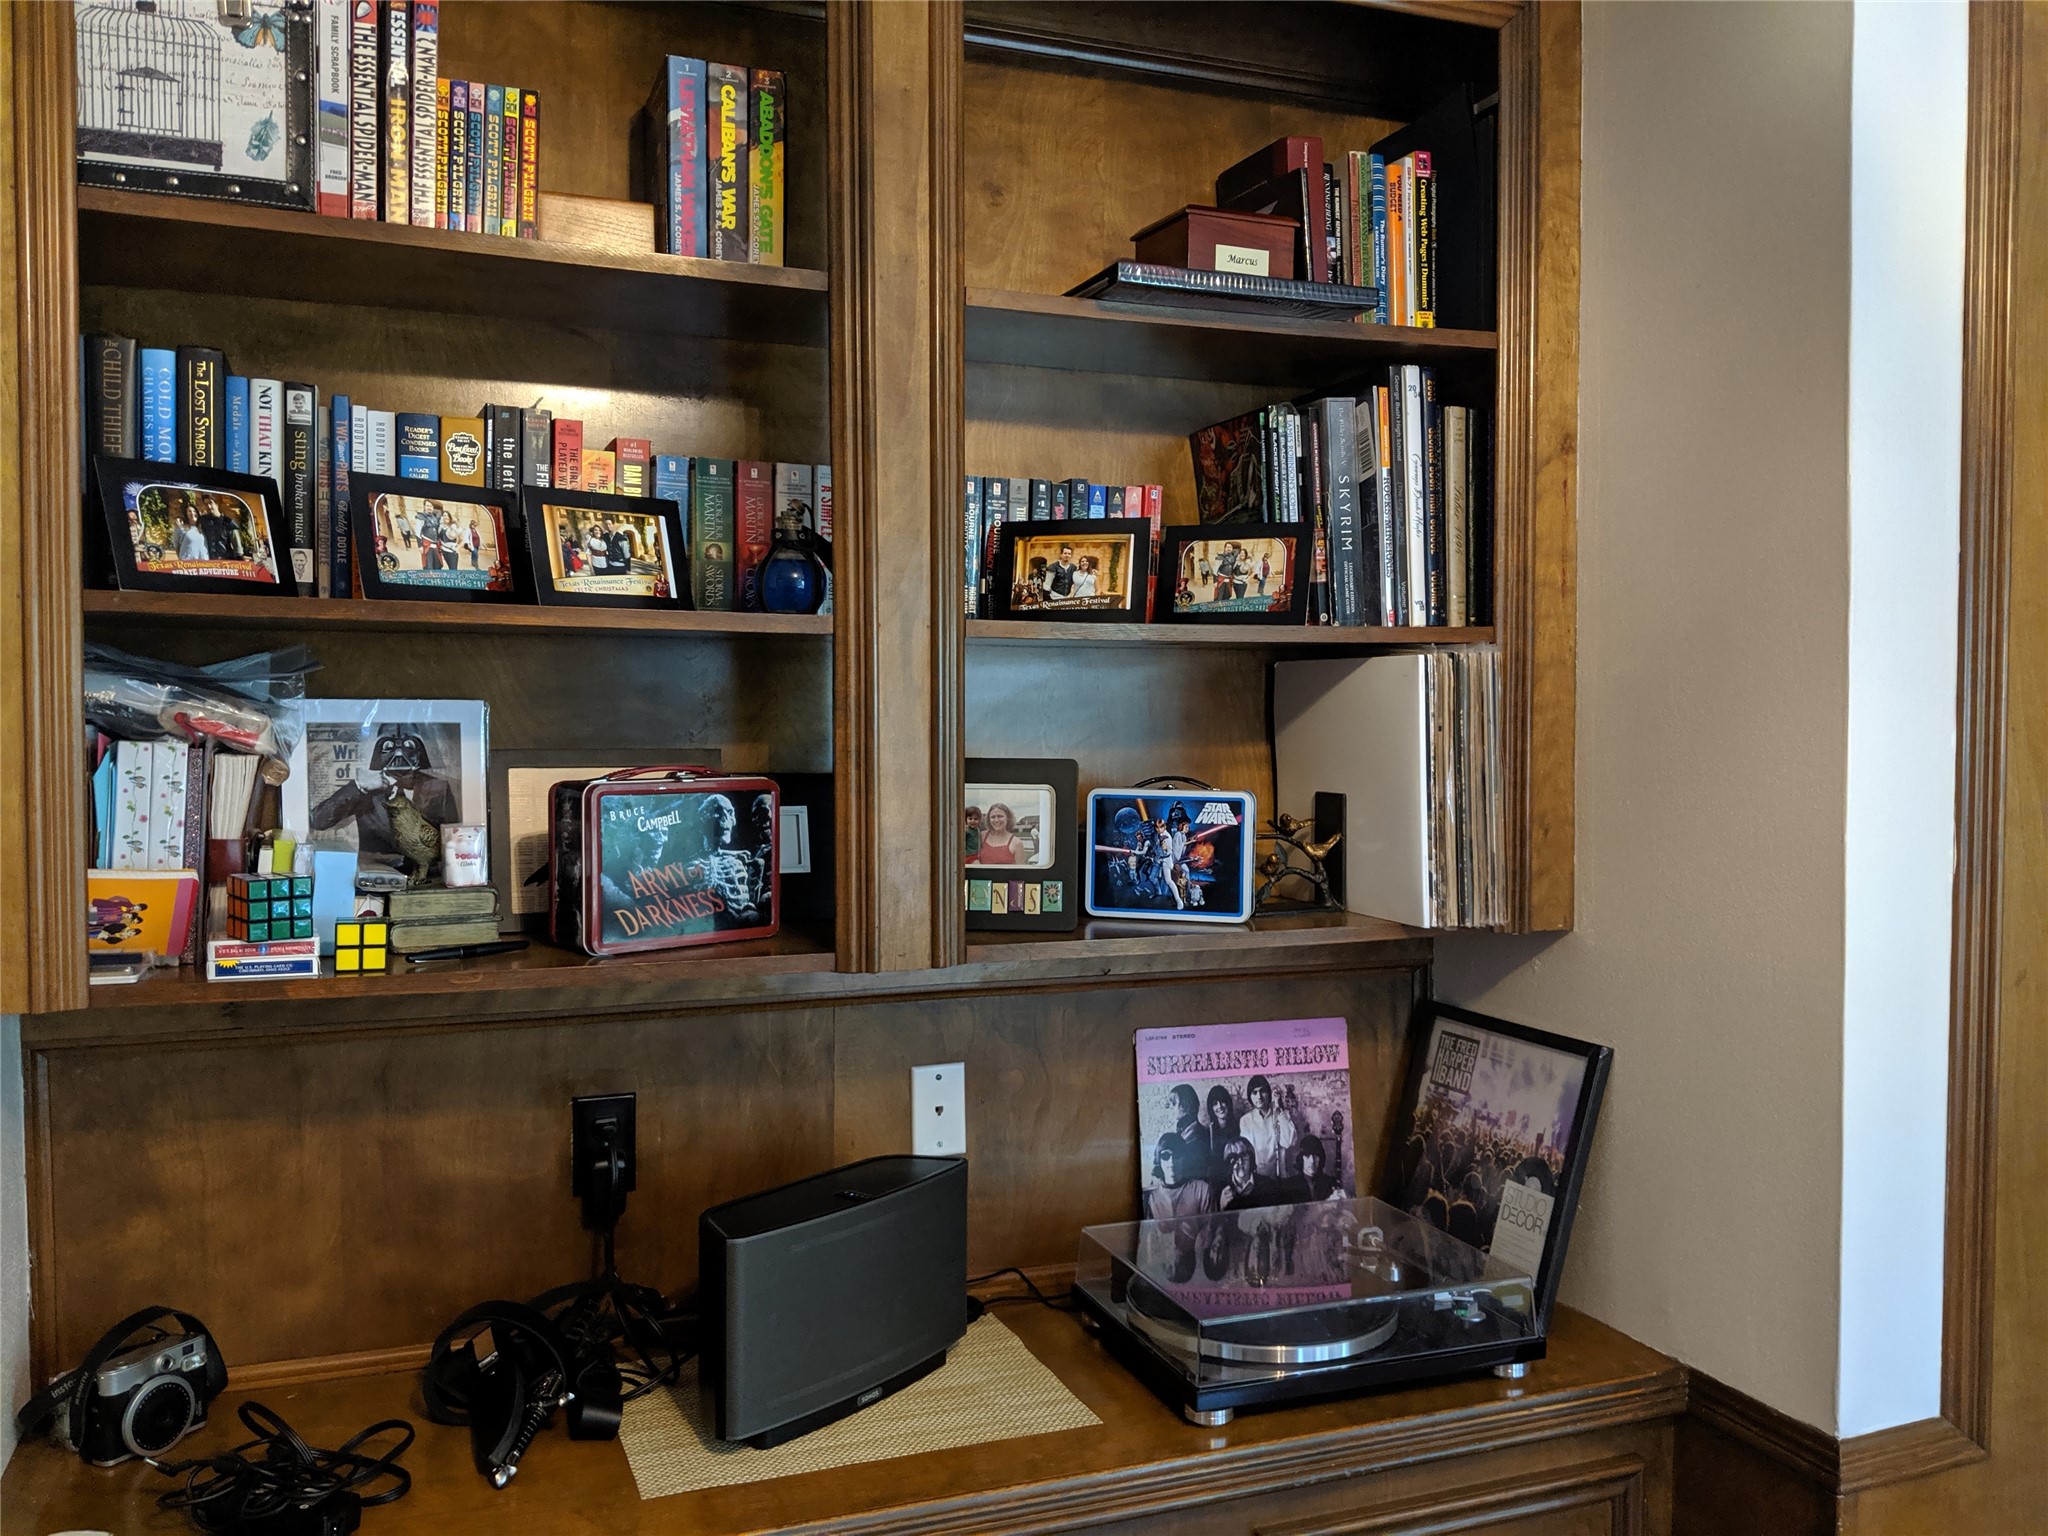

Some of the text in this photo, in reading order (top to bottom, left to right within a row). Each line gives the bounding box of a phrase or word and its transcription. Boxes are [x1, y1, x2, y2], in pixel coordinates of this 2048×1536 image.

[330, 15, 340, 94] FAMILY SCRAPBOOK
[354, 26, 376, 201] THE ESSENTIAL SPIDER-MAN
[388, 10, 406, 222] ESSENTIAL IRON MAN
[413, 47, 436, 206] THE ESSENTIAL SPIDER-MAN
[679, 77, 696, 188] LEVIATHAN
[721, 84, 736, 182] CALIBAN'S
[758, 91, 774, 200] ABADDON'S
[437, 110, 448, 212] SCOTT PILGRIM
[452, 111, 464, 214] SCOTT PILGRIM
[469, 113, 481, 215] SCOTT PILGRIM
[487, 114, 499, 216] SCOTT PILGRIM
[504, 117, 516, 219] SCOTT PILGRIM
[522, 120, 536, 222] SCOTT PILGRIM
[722, 188, 736, 230] WAR
[1419, 179, 1428, 216] Creating
[760, 204, 774, 255] GATE
[752, 236, 760, 264] COREY
[1226, 254, 1258, 267] Marcus
[1420, 236, 1428, 262] Pages
[1421, 268, 1429, 308] Dummies
[196, 361, 206, 378] The
[102, 348, 122, 454] CHILD THIEF
[144, 366, 154, 430] CHARLES
[158, 368, 171, 420] COLD
[1394, 375, 1402, 401] George
[232, 396, 242, 430] Medals
[258, 385, 272, 448] NOT THAT
[1394, 420, 1402, 434] High
[354, 416, 364, 446] RODDY
[376, 422, 386, 448] RODDY
[400, 438, 438, 448] CONDENSED
[404, 426, 434, 434] READER'S
[452, 454, 474, 465] Books
[502, 438, 516, 459] the
[558, 442, 568, 474] PLAYED
[320, 460, 330, 488] PINTS
[336, 461, 349, 492] PINTS
[536, 463, 549, 472] THE
[569, 448, 579, 487] THE GIRL
[598, 475, 608, 490] THE
[624, 464, 642, 484] DAN
[1288, 450, 1296, 490] ROBINSON'S
[291, 430, 312, 543] sting broken music
[704, 492, 715, 540] MARTIN
[714, 494, 723, 524] GEORGE
[746, 496, 756, 543] MARTIN
[756, 497, 764, 528] GEORGE
[1016, 506, 1026, 521] THE
[1338, 475, 1353, 551] SKYRIM
[320, 504, 330, 566] RODDY DOYLE
[336, 500, 348, 564] Roddy DOYLE
[993, 513, 1002, 554] BOURNE
[1383, 477, 1394, 578] ROCKS MINERALS
[147, 562, 253, 572] Texas Renaissance Festival
[426, 578, 472, 587] CHRISTMAS
[559, 580, 624, 588] Texas Renaissance
[705, 564, 716, 606] SWORDS
[716, 568, 724, 600] STORM
[968, 586, 976, 614] ROBERT
[1040, 600, 1081, 610] Renaissance
[1082, 597, 1111, 606] Festival
[336, 764, 351, 778] of
[610, 806, 646, 822] BRUCE
[637, 810, 682, 833] CAMPBELL
[1194, 812, 1238, 826] WARS
[1203, 802, 1232, 813] STAR
[627, 861, 688, 900] ARMY
[614, 888, 727, 936] DARKNESS
[1147, 1044, 1340, 1076] SURREALISTIC PILLOW
[1438, 1048, 1476, 1071] HARPER
[1440, 1034, 1479, 1056] THE FRED
[1436, 1068, 1472, 1092] BAND
[1506, 1186, 1548, 1218] STUDIO
[1500, 1204, 1544, 1236] DECOR
[861, 1390, 880, 1403] SONOS
